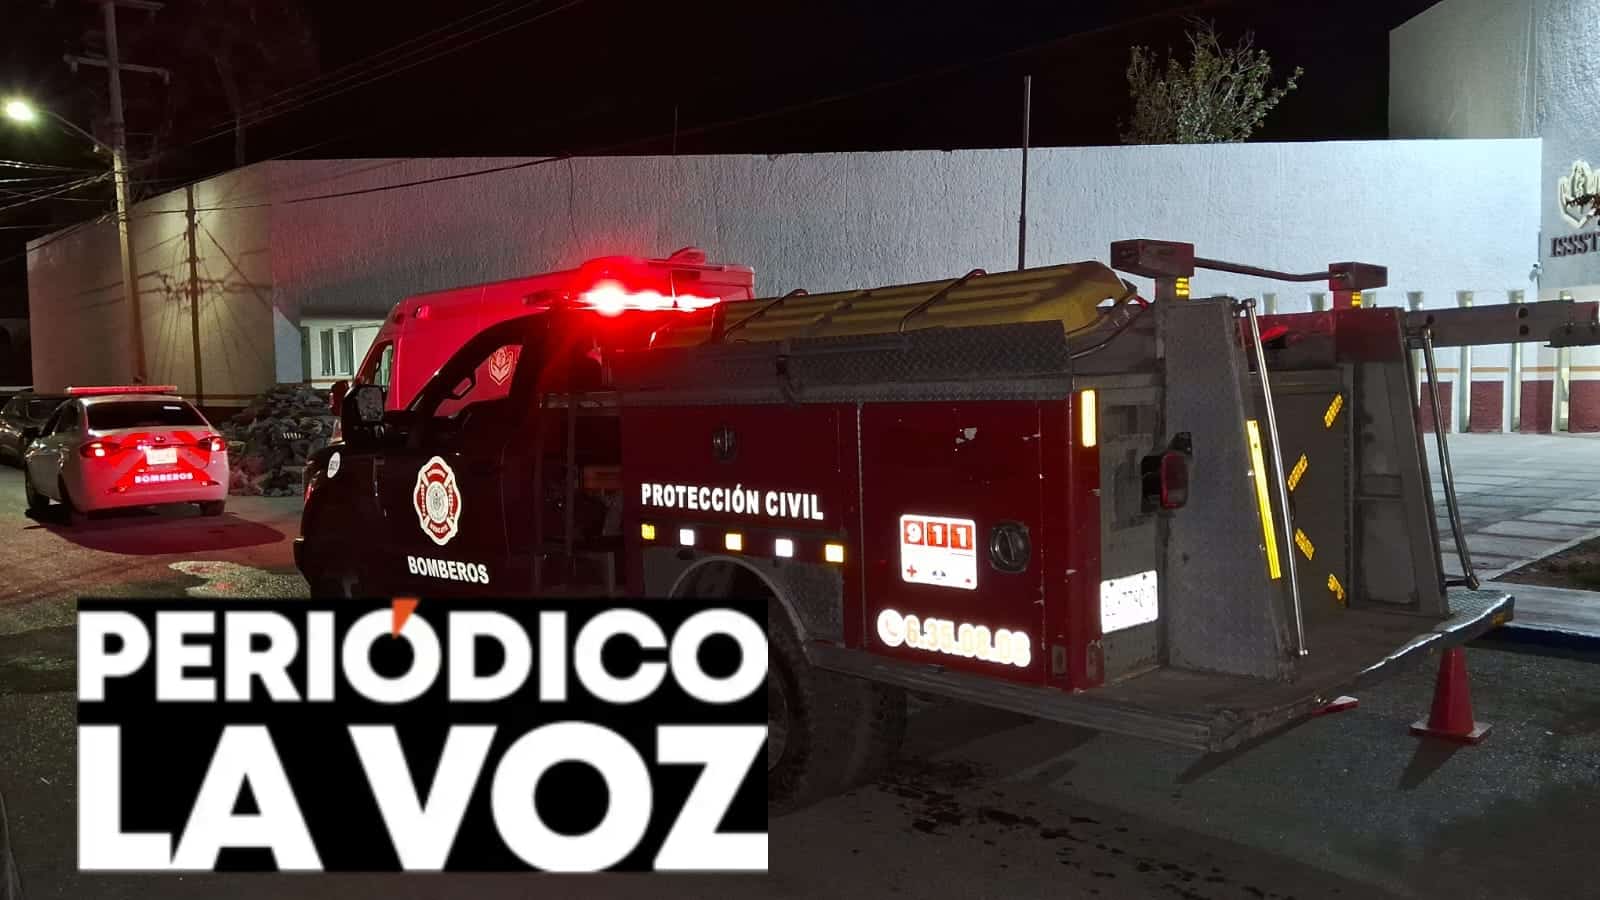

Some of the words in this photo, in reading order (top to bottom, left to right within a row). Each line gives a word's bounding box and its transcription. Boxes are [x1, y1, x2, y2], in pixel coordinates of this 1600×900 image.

[135, 472, 193, 484] BOMBEROS
[641, 483, 759, 515] PROTECCIÓN
[765, 491, 824, 521] CIVIL
[906, 521, 973, 549] 911
[407, 555, 490, 584] BOMBEROS
